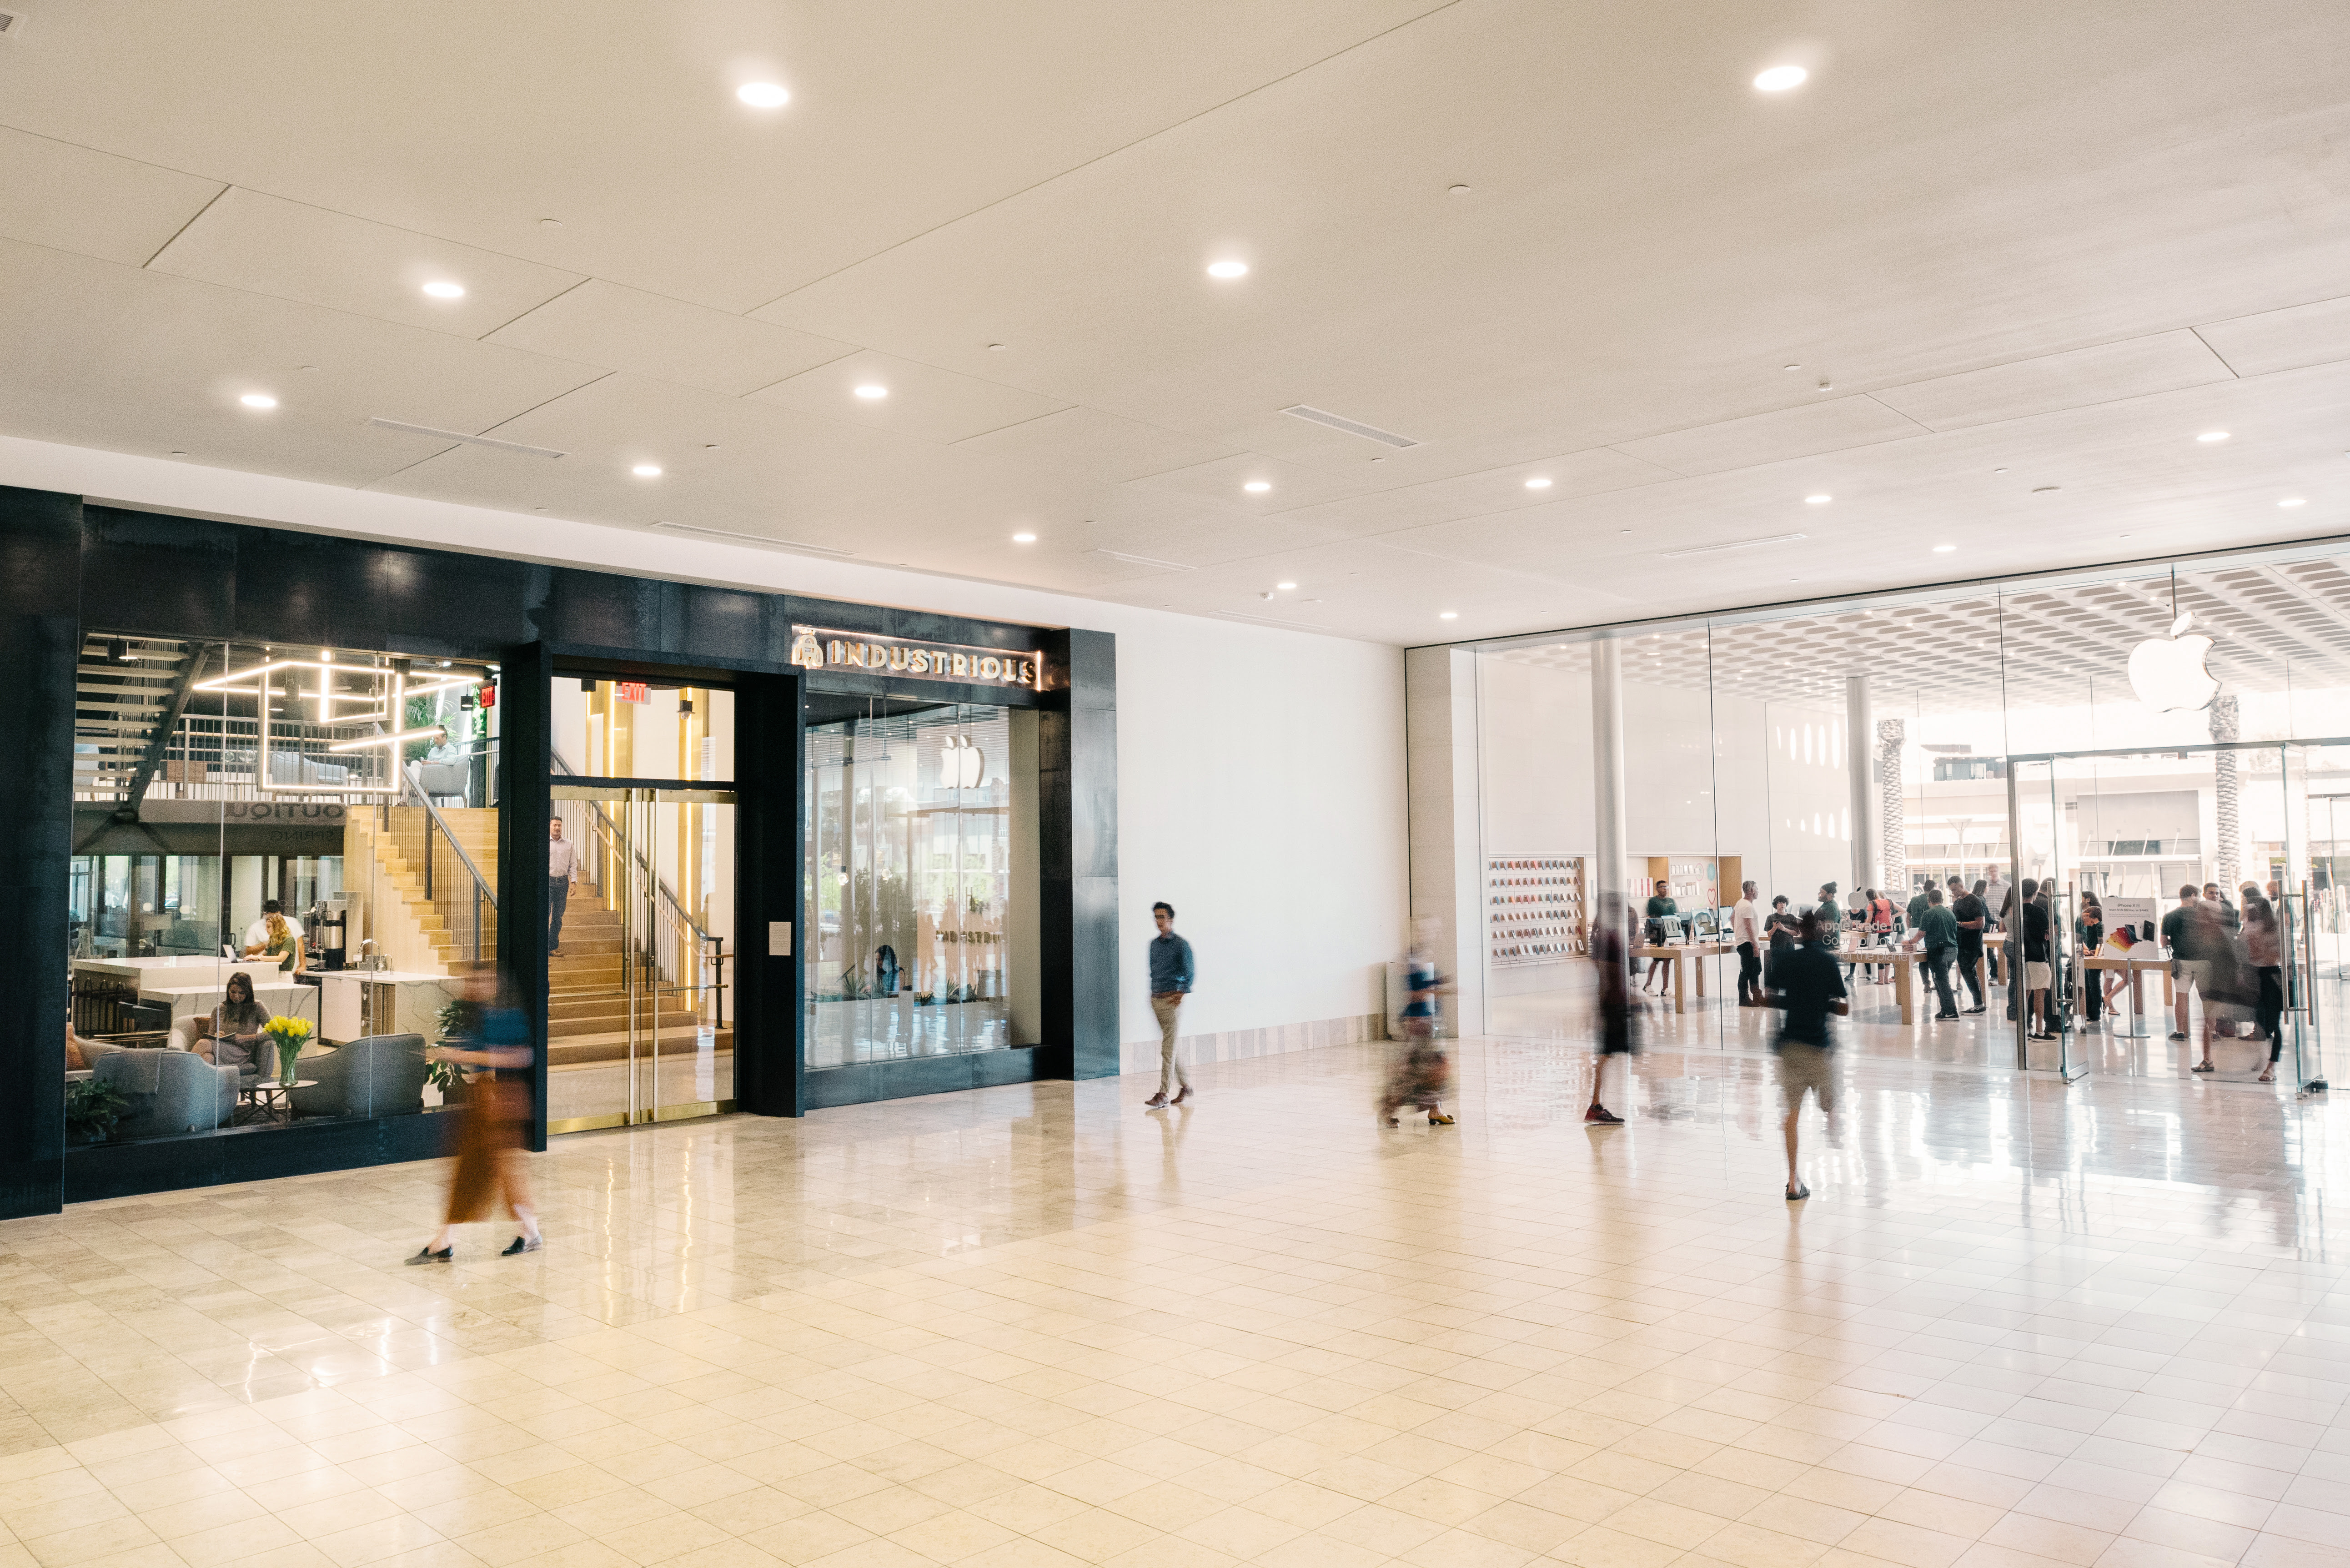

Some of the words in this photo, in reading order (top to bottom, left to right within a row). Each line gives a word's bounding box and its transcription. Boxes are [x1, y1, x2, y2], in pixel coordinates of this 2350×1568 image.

[831, 640, 1037, 683] INDUSTRIOUS
[622, 682, 647, 702] EXIT
[1817, 920, 1853, 933] Apple
[1855, 920, 1887, 931] Trade
[1823, 934, 1852, 945] Good
[1839, 950, 1852, 960] for
[1856, 950, 1874, 960] the
